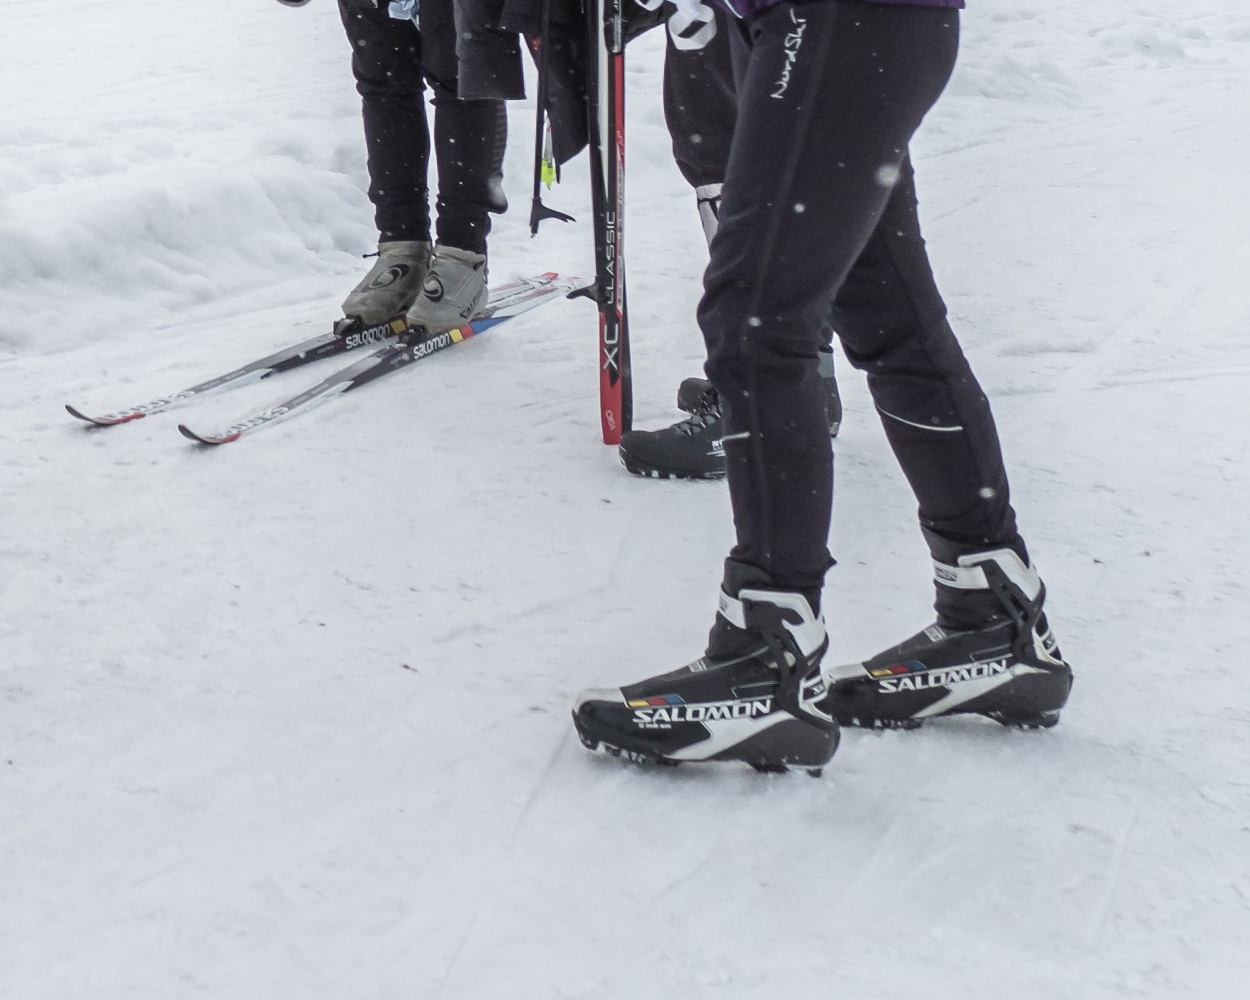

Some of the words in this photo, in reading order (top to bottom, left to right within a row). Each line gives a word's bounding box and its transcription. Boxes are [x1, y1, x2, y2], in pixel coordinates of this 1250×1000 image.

[345, 323, 390, 350] salomon
[413, 333, 450, 360] salomon
[603, 323, 619, 371] XC
[878, 659, 1008, 693] SALOMON
[633, 699, 772, 724] SALOMON
